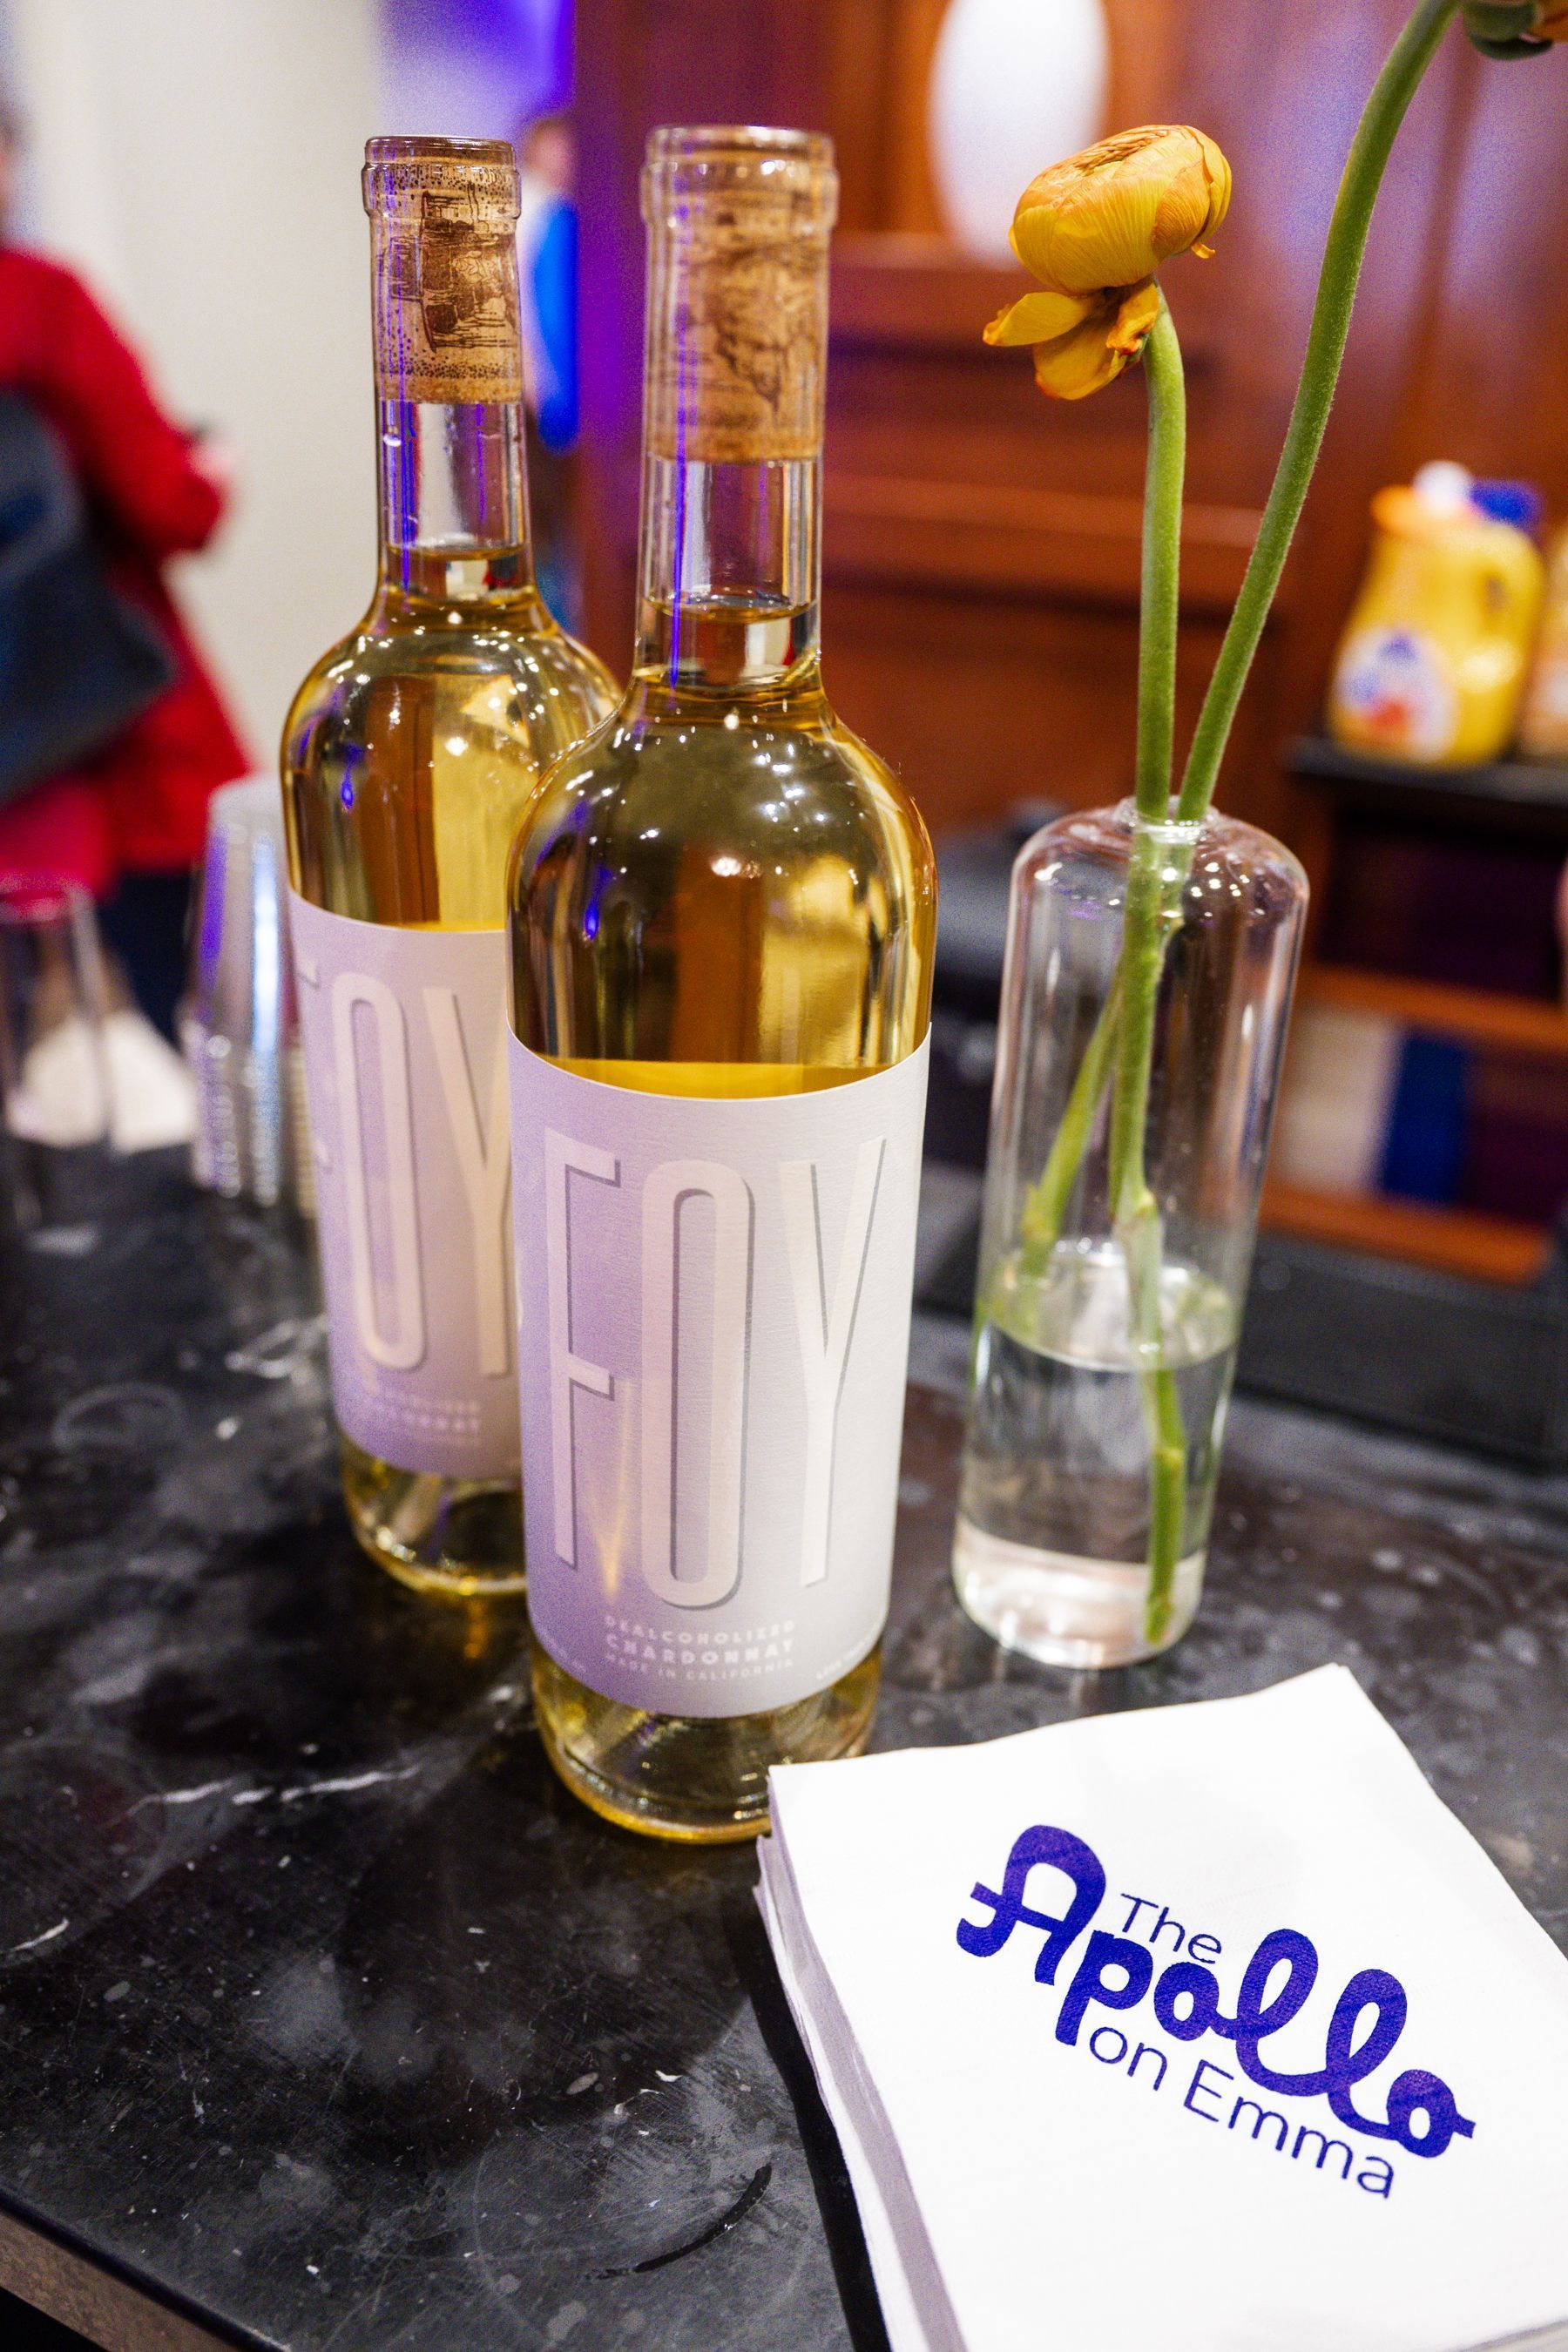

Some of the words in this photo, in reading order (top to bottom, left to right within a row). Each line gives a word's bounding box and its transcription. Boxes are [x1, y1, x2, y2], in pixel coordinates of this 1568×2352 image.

[544, 1129, 887, 1612] FOY
[605, 1633, 794, 1665] CHARDONNAY
[658, 1666, 677, 1680] IN
[686, 1658, 793, 1680] CALIFORNIA
[1120, 1893, 1222, 1965] The
[956, 1824, 1477, 2159] Apollo
[1089, 2026, 1168, 2092] on
[1182, 2059, 1395, 2199] Emma
